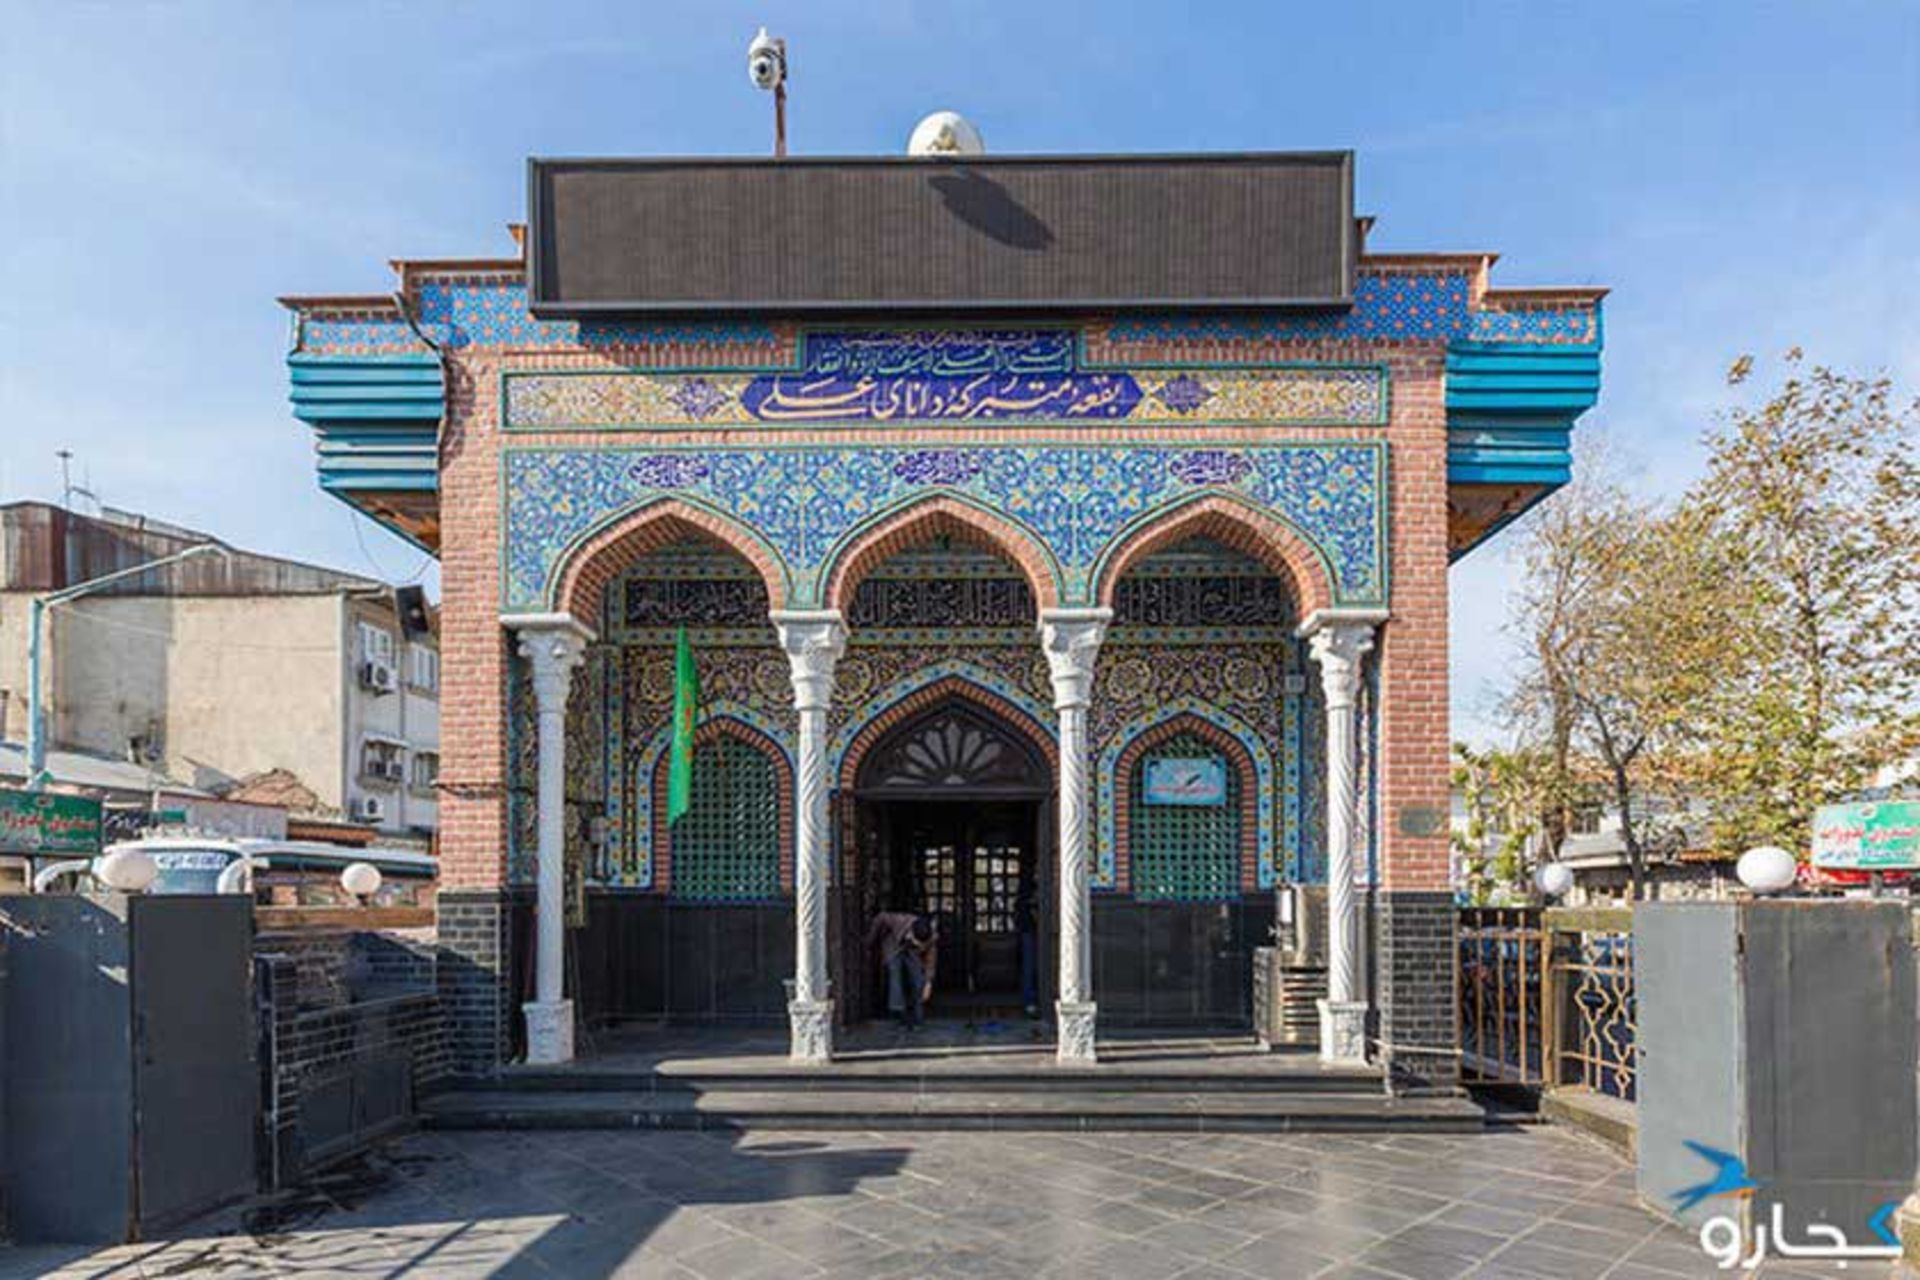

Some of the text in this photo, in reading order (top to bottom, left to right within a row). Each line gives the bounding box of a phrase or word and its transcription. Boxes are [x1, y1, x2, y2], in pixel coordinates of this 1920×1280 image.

[759, 374, 879, 420] علی
[872, 377, 944, 419] دانای
[1066, 376, 1121, 415] بقعه
